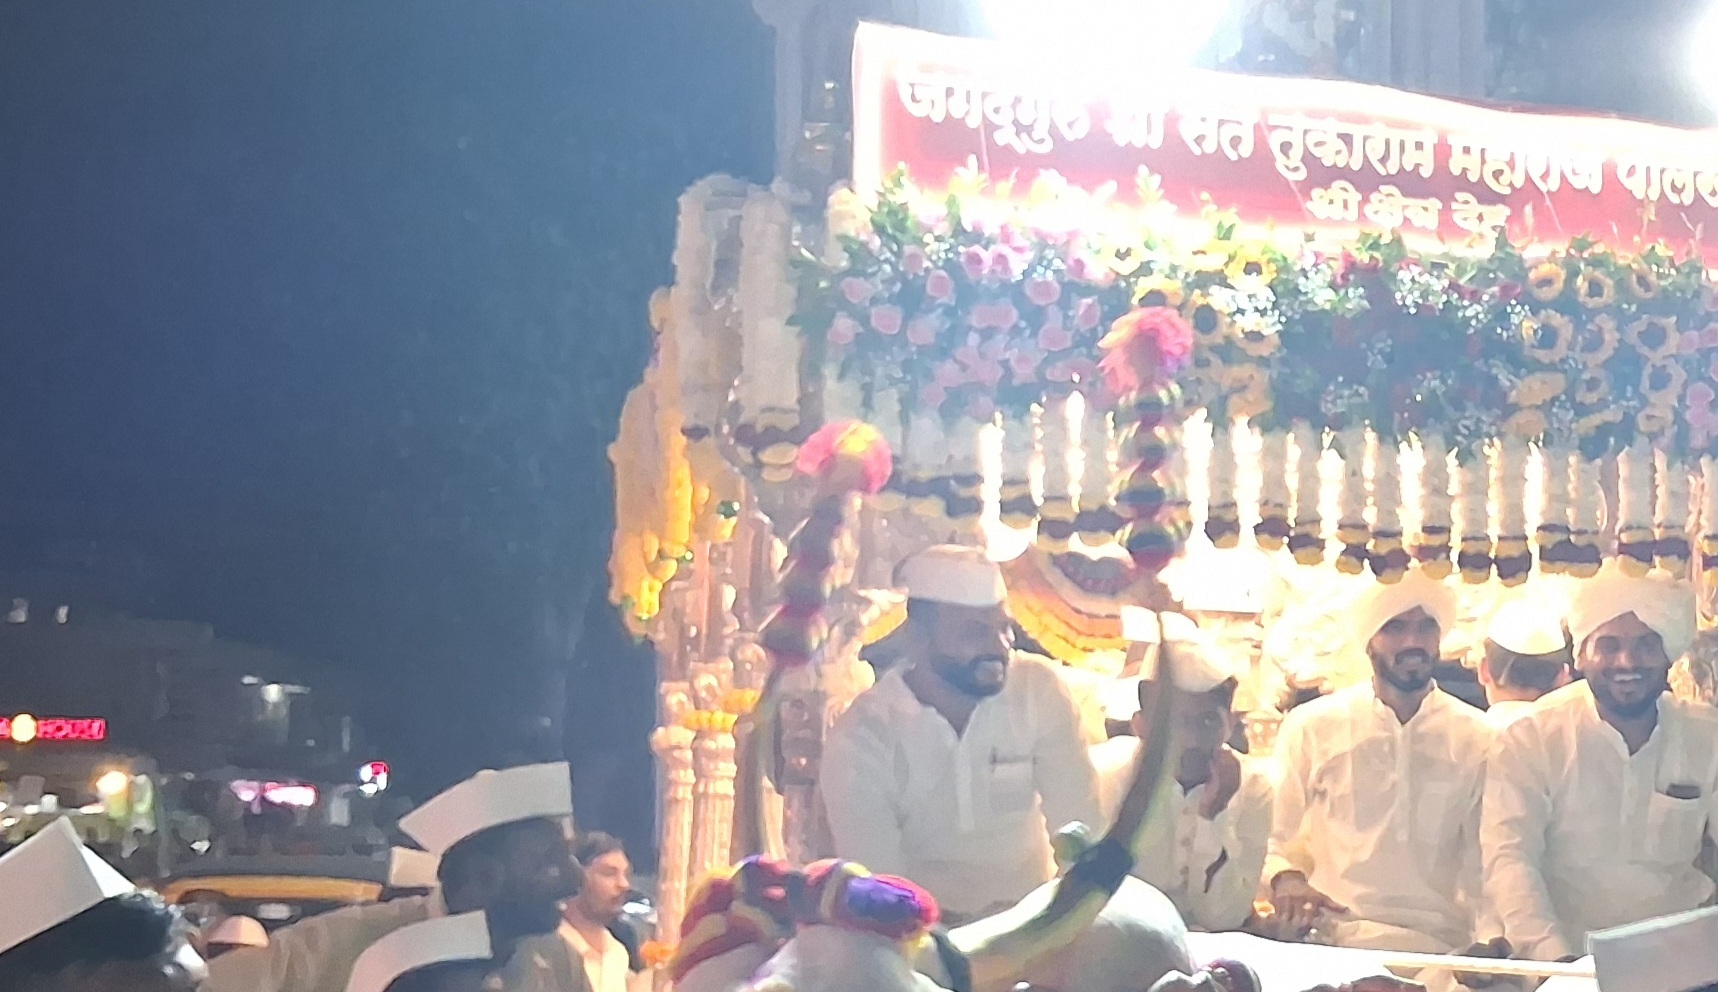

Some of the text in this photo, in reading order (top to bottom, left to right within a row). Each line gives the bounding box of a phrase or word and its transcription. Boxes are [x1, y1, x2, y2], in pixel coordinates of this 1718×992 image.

[1266, 112, 1439, 181] तुकाराम
[1447, 134, 1604, 195] महाराज
[1305, 179, 1362, 222] श्री
